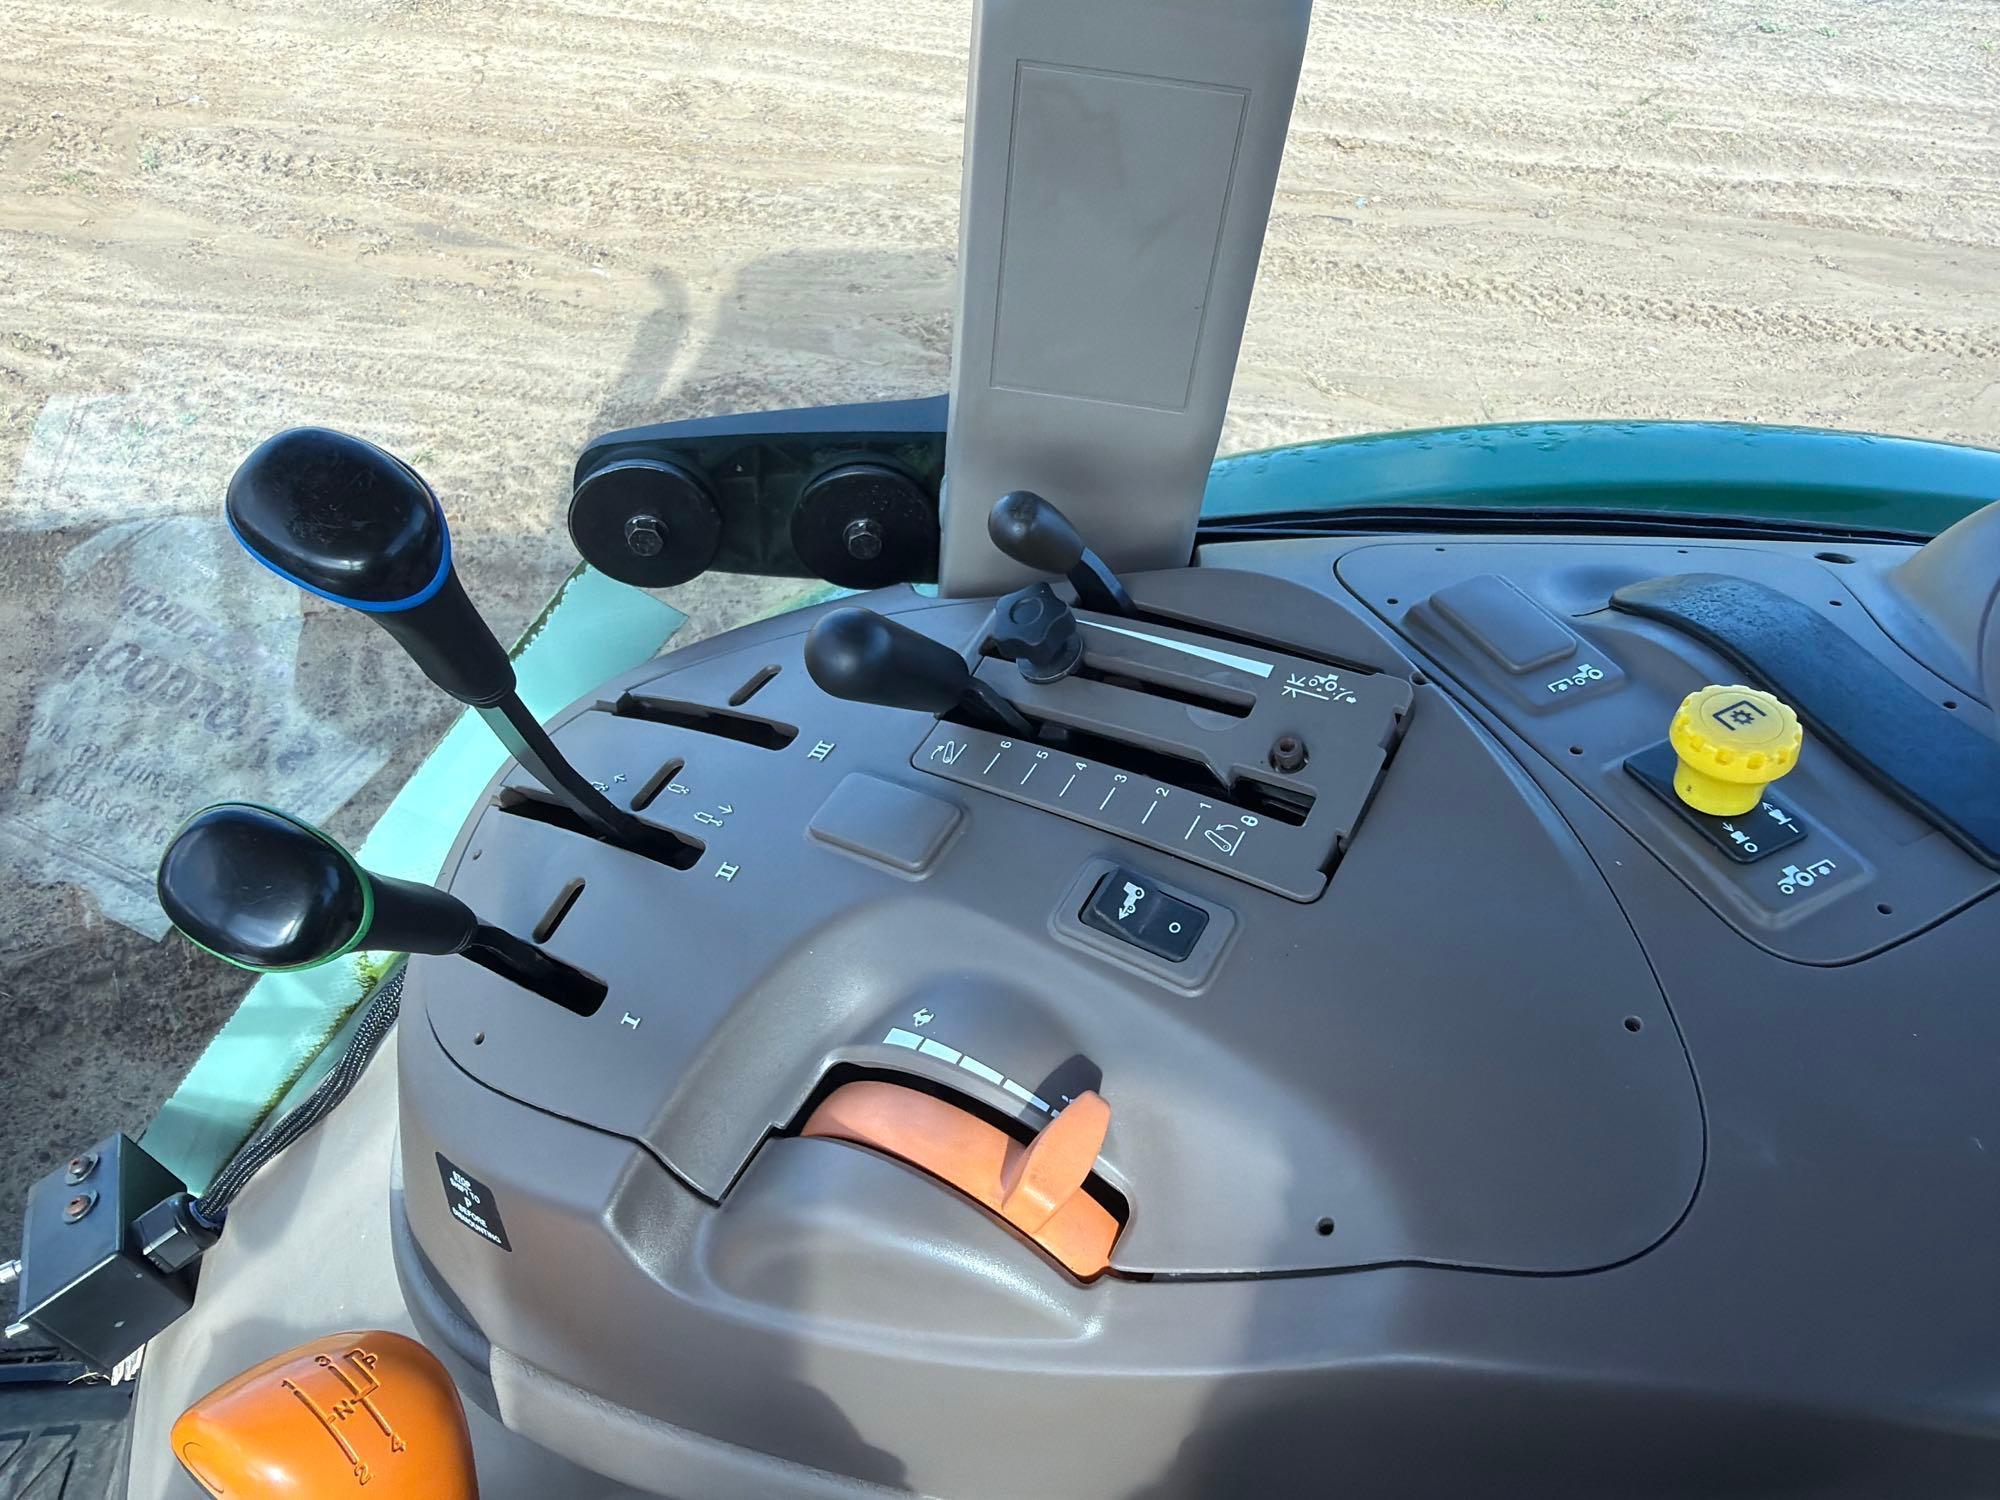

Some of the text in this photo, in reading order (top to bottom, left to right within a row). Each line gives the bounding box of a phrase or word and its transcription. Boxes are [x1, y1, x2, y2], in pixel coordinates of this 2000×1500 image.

[1000, 740, 1012, 750] 6
[1036, 750, 1049, 760] 5
[1075, 761, 1088, 772] 4
[1114, 773, 1128, 784] 3
[1155, 786, 1170, 797] 2
[1199, 802, 1212, 810] 1
[314, 1352, 333, 1368] 3
[333, 1399, 355, 1421] N
[391, 1434, 407, 1453] 4
[353, 1463, 372, 1486] 2
